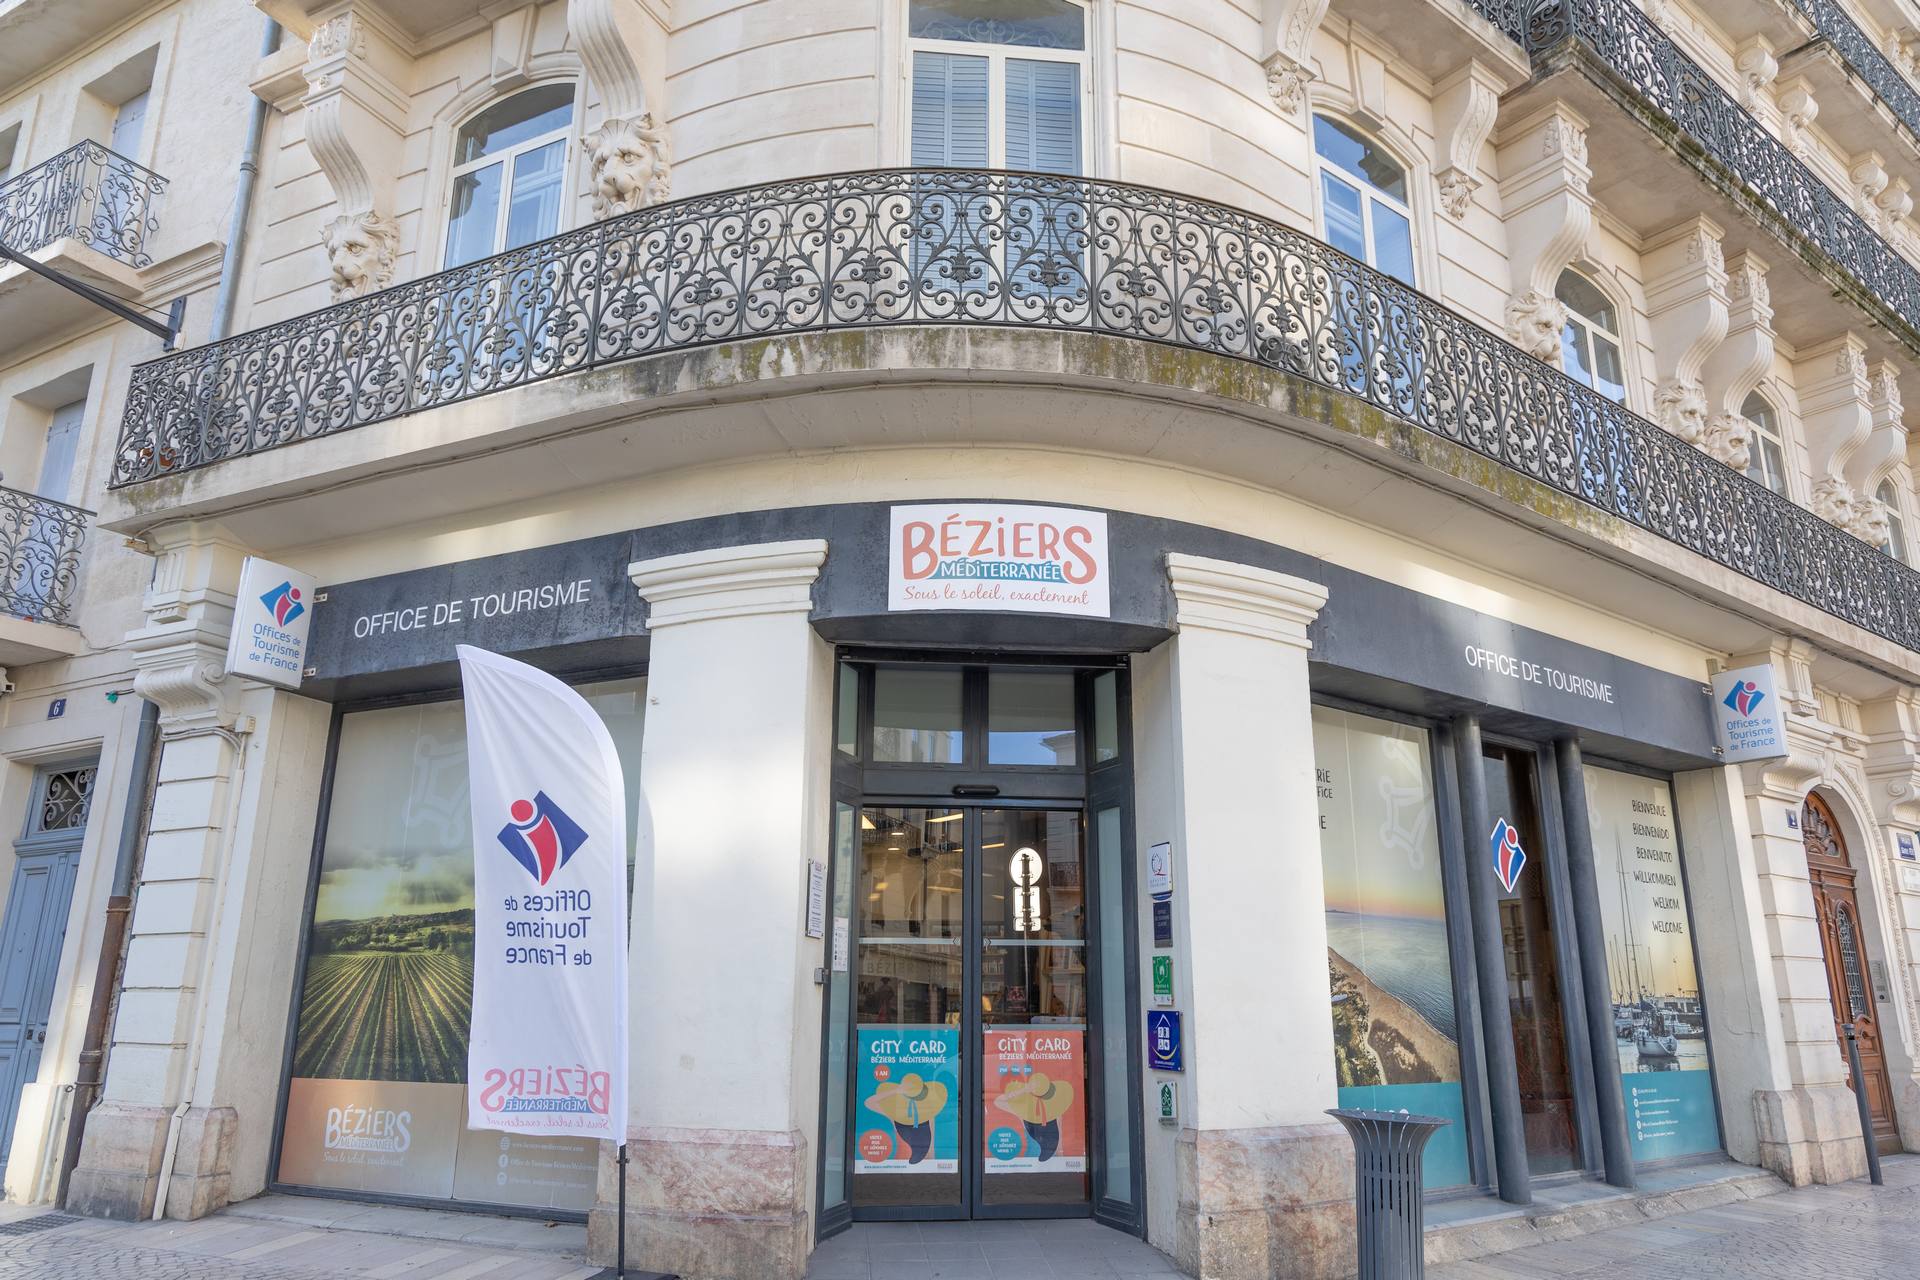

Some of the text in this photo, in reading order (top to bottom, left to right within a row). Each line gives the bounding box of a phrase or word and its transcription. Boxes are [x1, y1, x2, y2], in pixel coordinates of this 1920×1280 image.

[903, 584, 940, 600] Sous
[944, 583, 958, 599] le
[1010, 587, 1089, 605] exactement
[354, 579, 591, 638] OFFICE DE TOURISME
[253, 623, 302, 646] Offices de
[253, 636, 299, 659] Tourisme
[249, 652, 298, 671] de France
[1465, 645, 1614, 703] OFFICE DE TOURISME
[53, 701, 61, 716] 6
[1726, 717, 1771, 730] Offices de
[1728, 727, 1773, 740] Tourisme
[1730, 737, 1775, 751] de France
[1636, 846, 1673, 863] BENVENUTO
[1652, 897, 1680, 911] WELKOM
[1652, 920, 1684, 934] WELCOME
[909, 1039, 947, 1054] CARD
[1035, 1038, 1071, 1051] CARD
